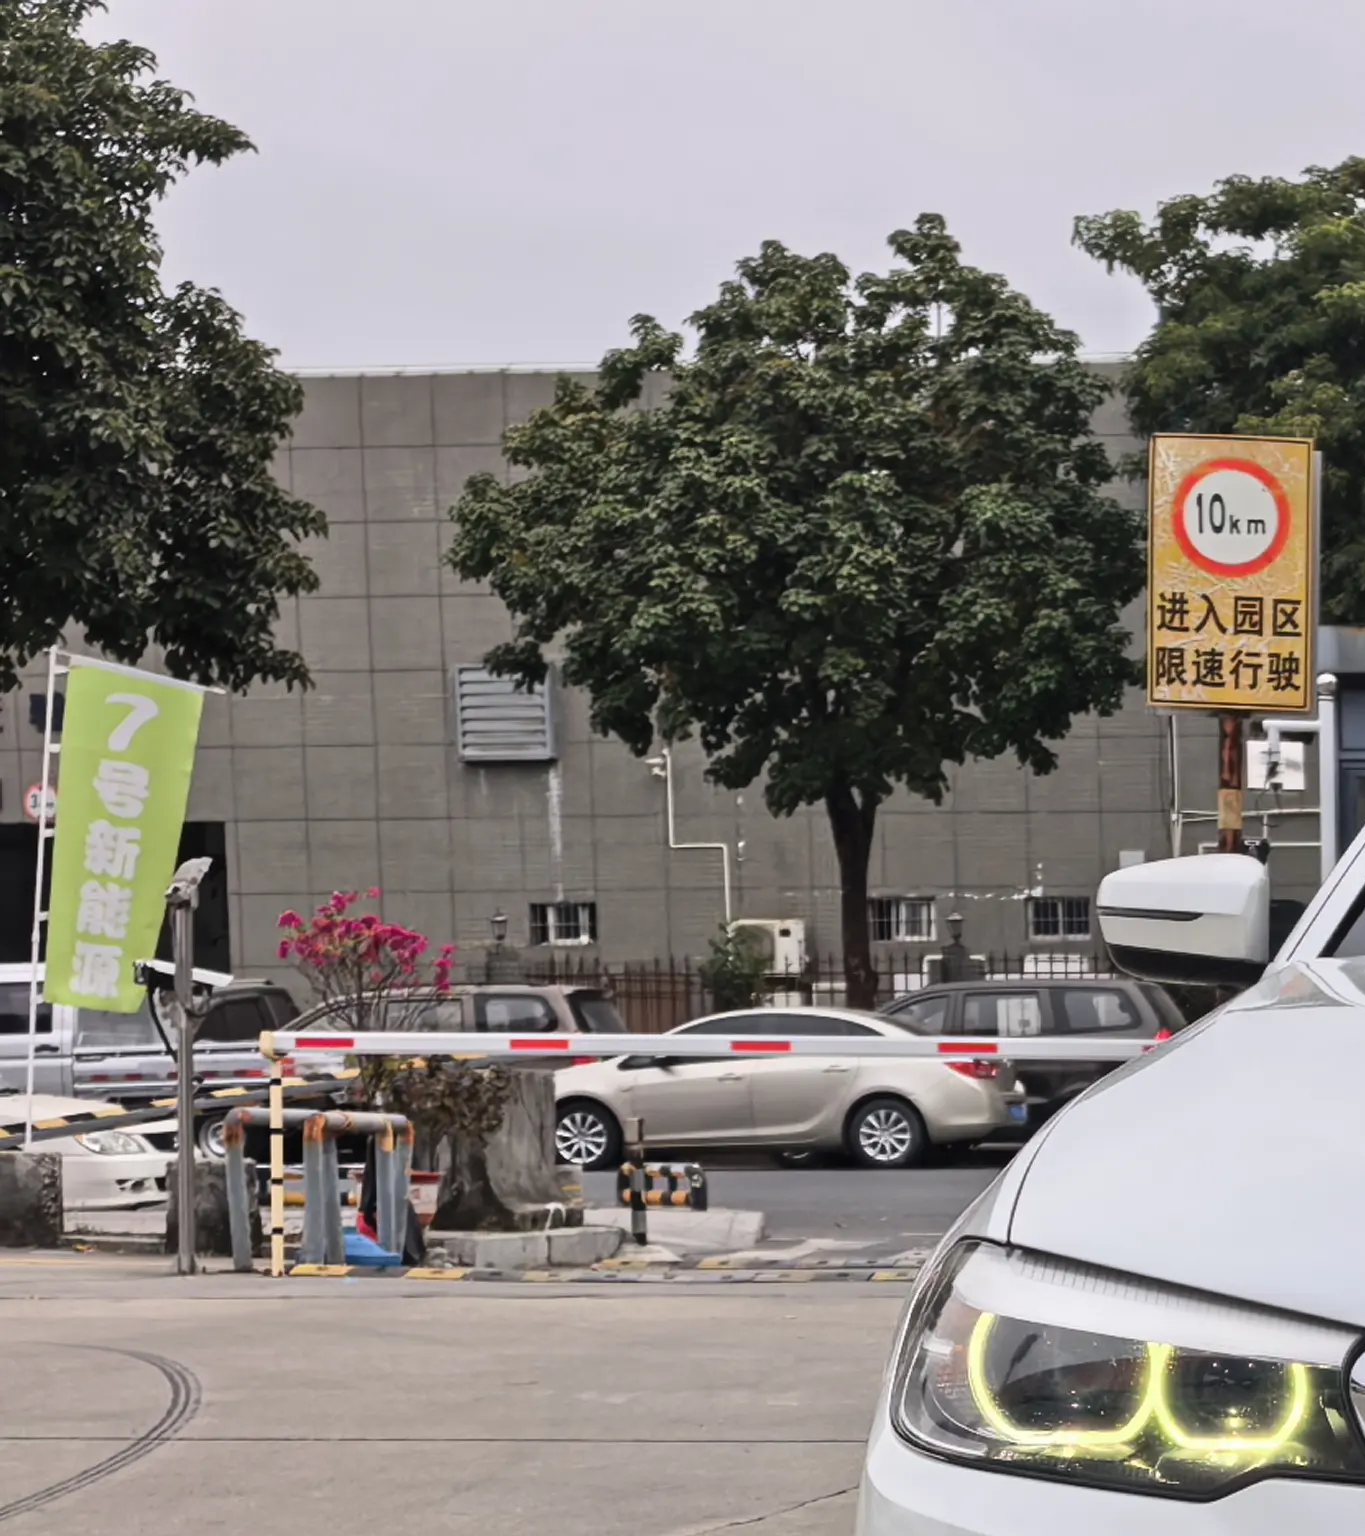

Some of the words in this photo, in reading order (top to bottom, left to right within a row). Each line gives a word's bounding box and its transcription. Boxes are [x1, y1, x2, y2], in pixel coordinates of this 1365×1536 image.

[1196, 493, 1266, 535] 10km
[1156, 592, 1302, 638] 进入园区
[1155, 647, 1301, 691] 限速行驶
